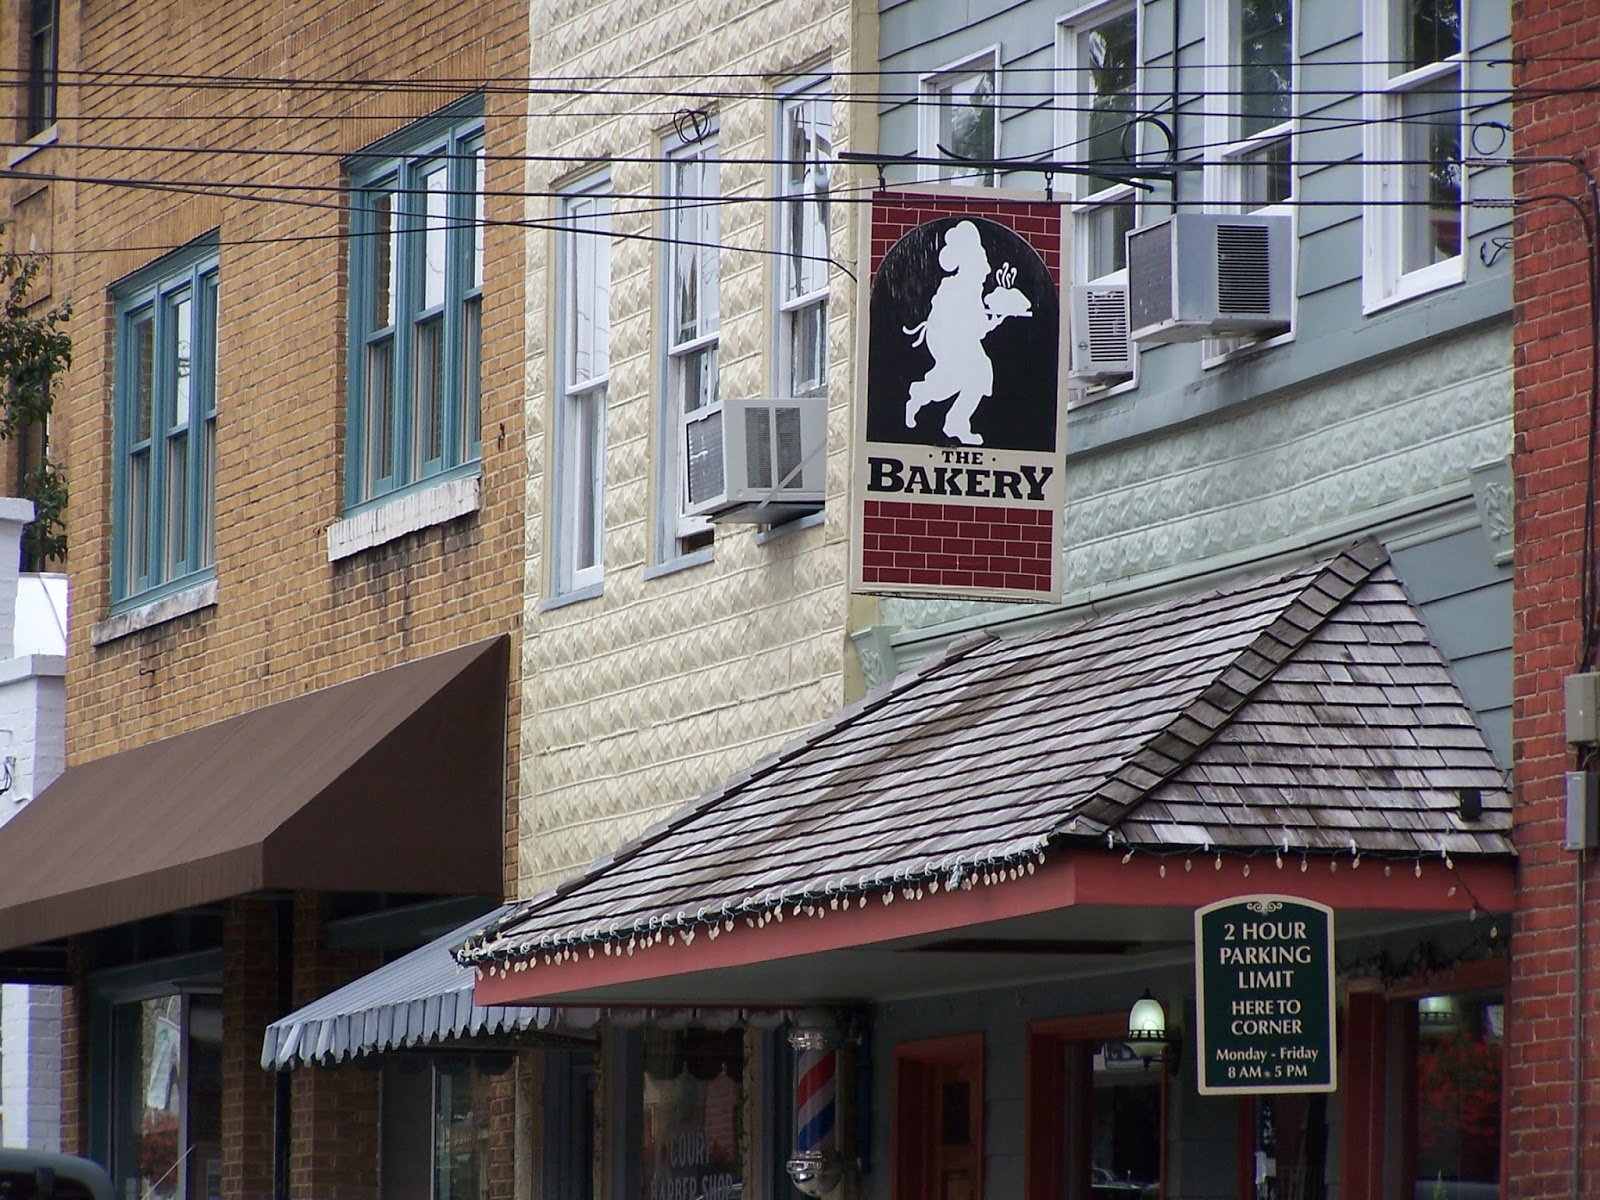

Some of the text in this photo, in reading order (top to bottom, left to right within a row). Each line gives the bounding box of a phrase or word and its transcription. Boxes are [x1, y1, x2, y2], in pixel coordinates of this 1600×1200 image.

[941, 450, 984, 465] THE
[867, 456, 1054, 501] BAKERY
[1224, 922, 1307, 941] 2 HOUR
[1219, 946, 1311, 965] PARKING
[1238, 970, 1295, 989] LIMIT
[1231, 999, 1301, 1016] HERE TO
[1231, 1019, 1302, 1036] CORNER
[1216, 1047, 1267, 1064] Monday
[1280, 1046, 1319, 1062] Friday
[1228, 1064, 1308, 1079] 8 AM 5 PM
[669, 1132, 710, 1168] COURT
